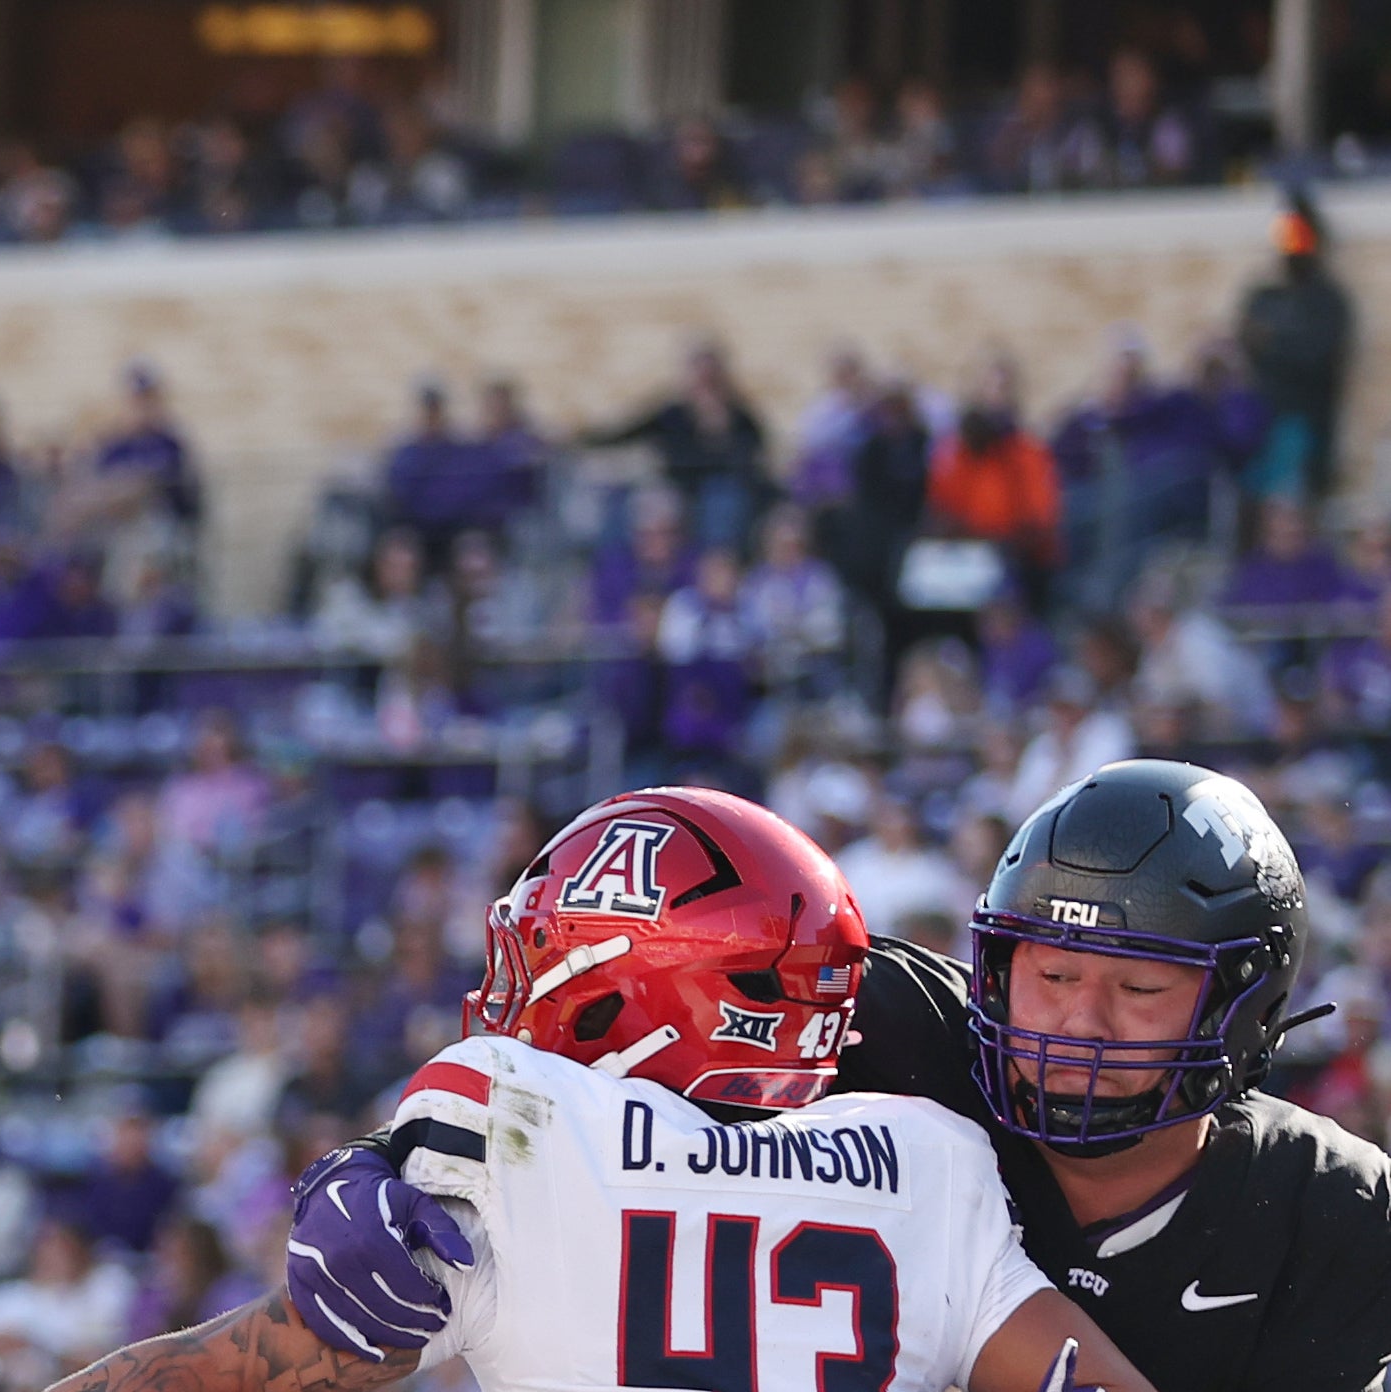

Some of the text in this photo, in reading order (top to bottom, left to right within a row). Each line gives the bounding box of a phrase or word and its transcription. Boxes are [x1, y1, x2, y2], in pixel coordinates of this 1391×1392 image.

[557, 818, 676, 921] A
[1050, 899, 1100, 928] TCU
[797, 1011, 841, 1059] 43
[621, 1100, 899, 1194] D. JOHNSON
[1068, 1267, 1110, 1297] TCU
